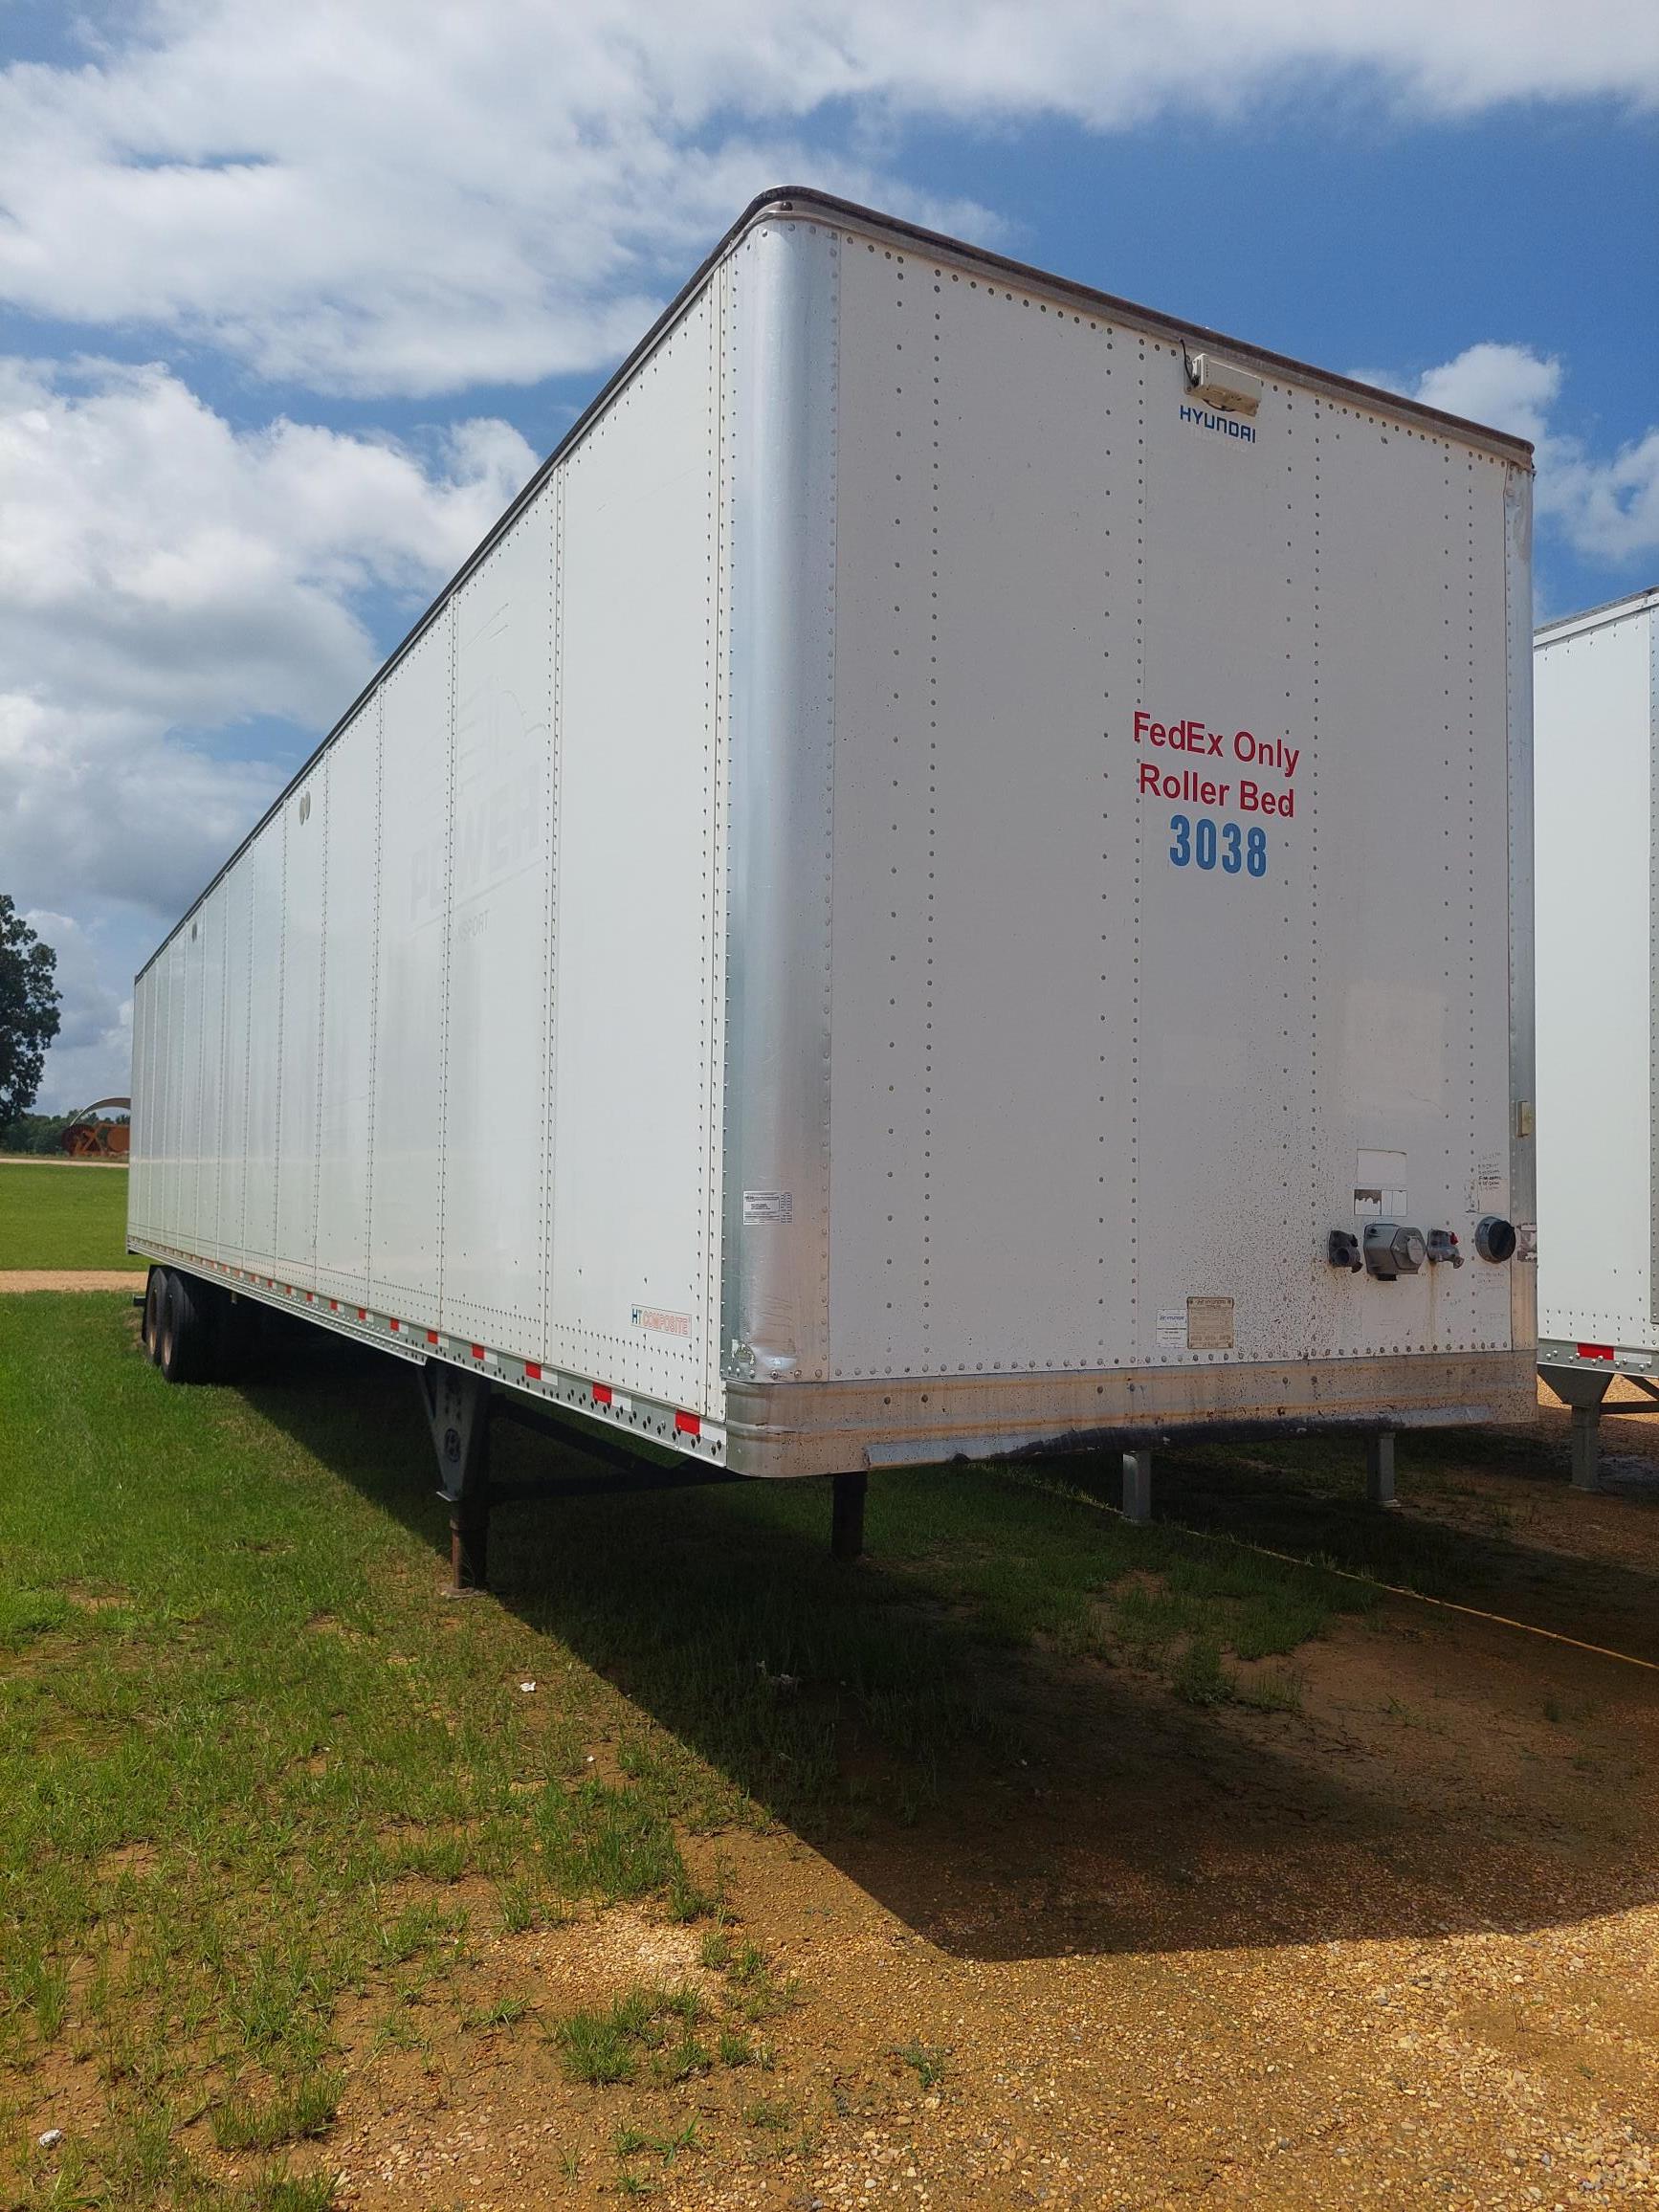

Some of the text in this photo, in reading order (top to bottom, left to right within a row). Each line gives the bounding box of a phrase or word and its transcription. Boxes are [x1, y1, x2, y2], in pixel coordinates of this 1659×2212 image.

[1180, 405, 1256, 443] HYUNDAI
[1134, 711, 1300, 778] FedEx Only
[1139, 763, 1294, 818] Roller Bed
[1169, 814, 1267, 877] 3038
